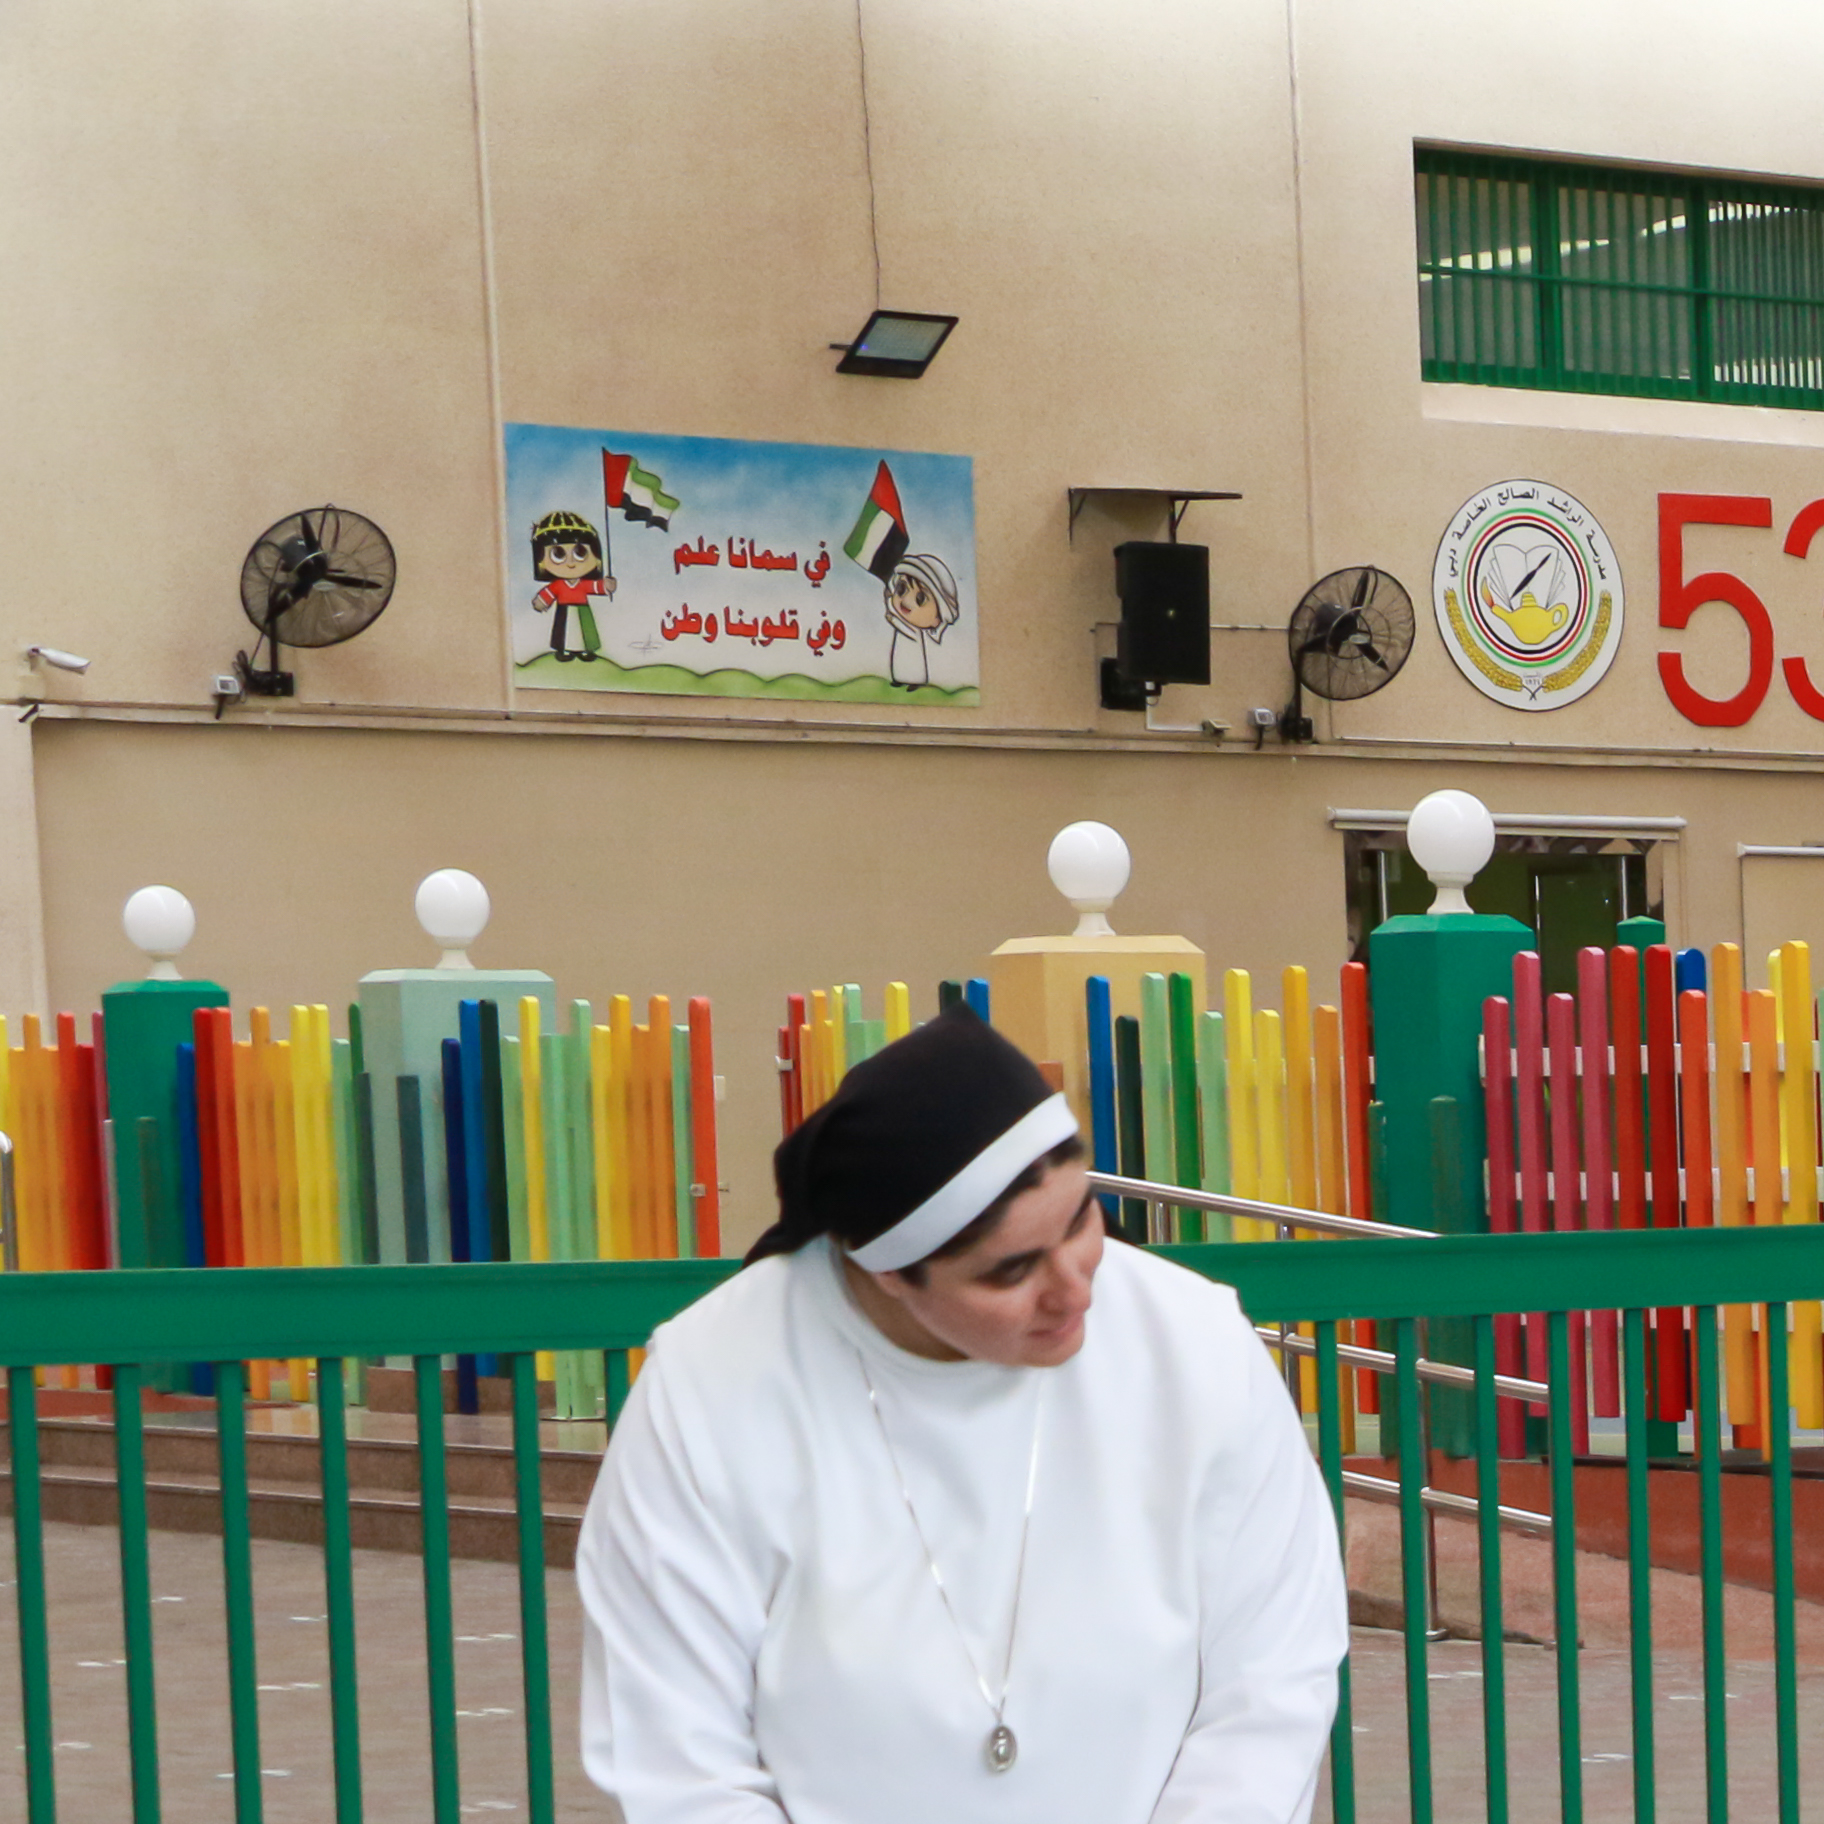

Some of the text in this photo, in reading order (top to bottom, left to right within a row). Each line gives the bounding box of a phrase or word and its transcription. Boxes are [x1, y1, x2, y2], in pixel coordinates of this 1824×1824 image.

[1497, 486, 1540, 506] الصالح
[673, 535, 720, 575] علم
[803, 540, 831, 588] في
[660, 602, 846, 657] وفي قلوبنا وطن
